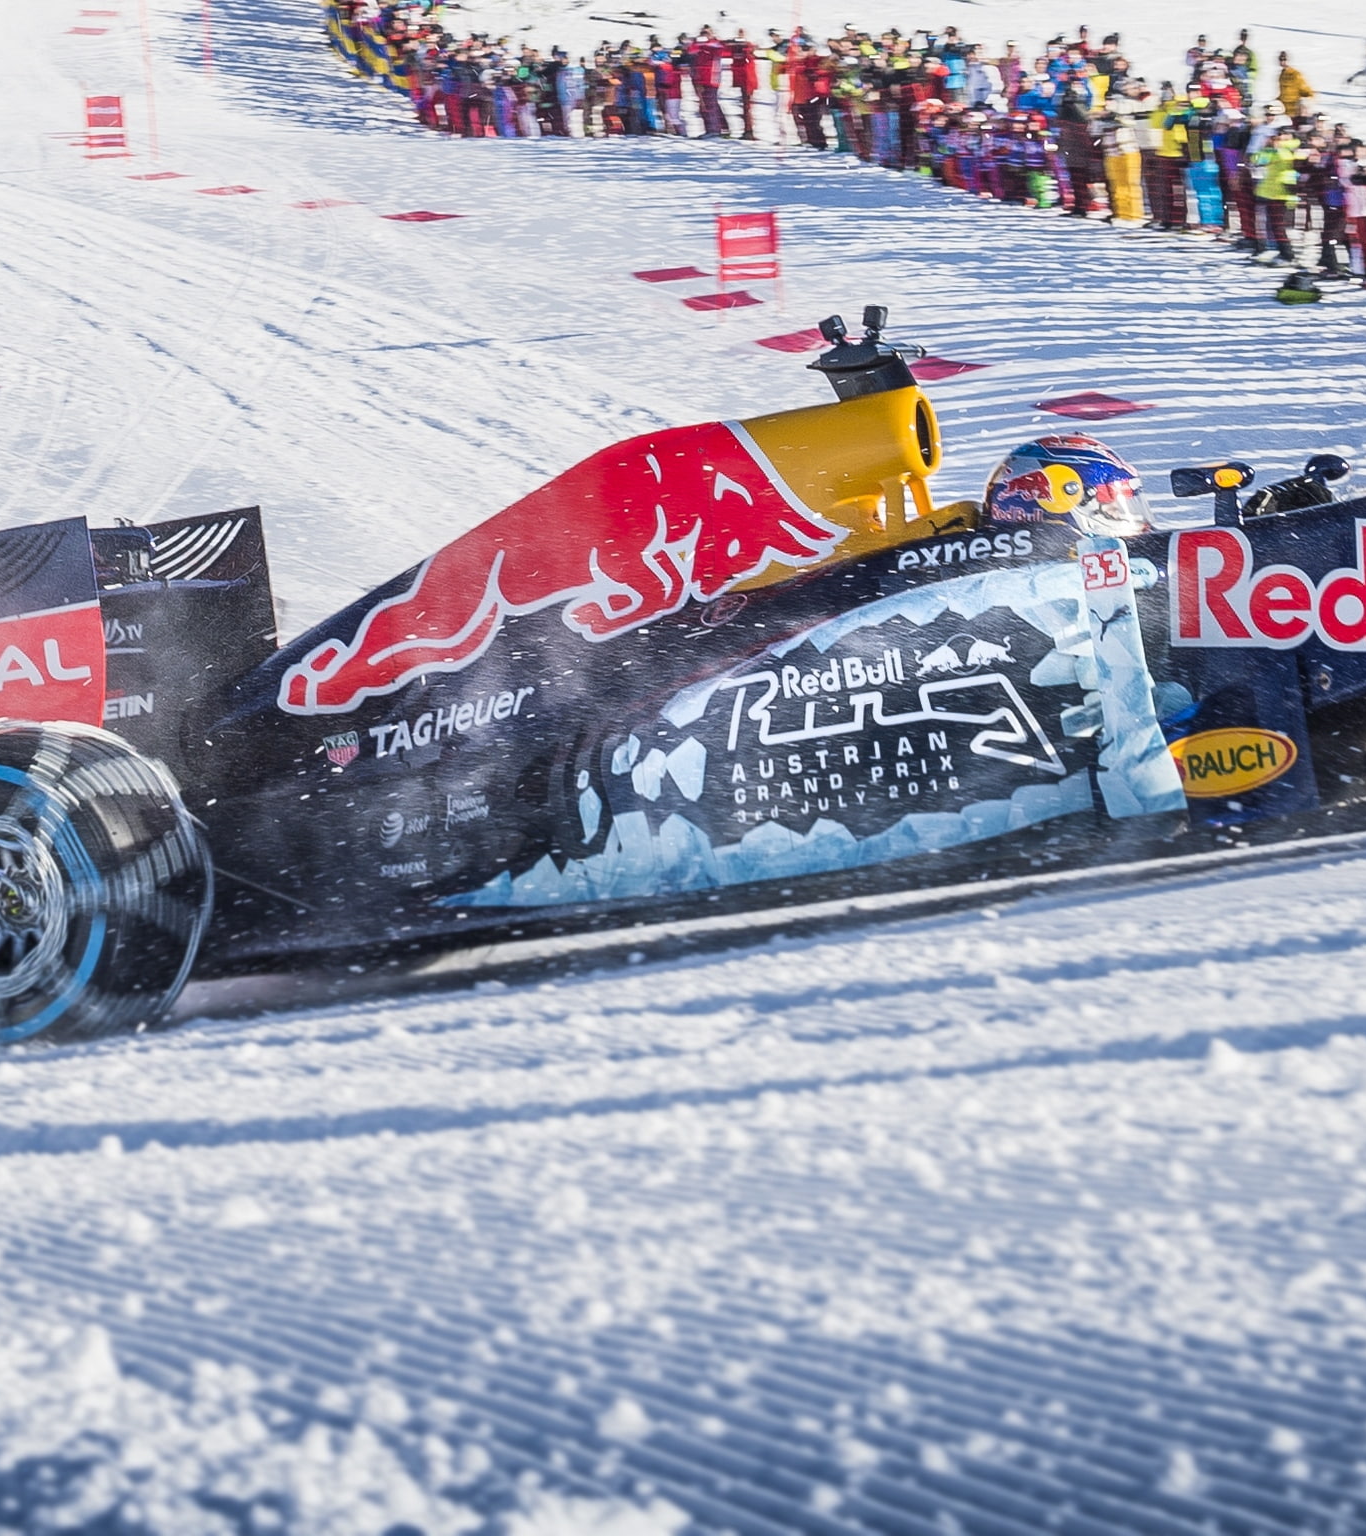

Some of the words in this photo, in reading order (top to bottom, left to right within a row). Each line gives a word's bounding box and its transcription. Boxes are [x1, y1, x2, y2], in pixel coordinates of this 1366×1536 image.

[897, 530, 1033, 571] exness
[1081, 549, 1129, 591] 33
[781, 657, 842, 699] Red
[843, 648, 905, 690] Bull
[326, 734, 357, 749] TAG
[731, 730, 948, 783] AUSTRIAN
[1186, 741, 1277, 781] RAUCH
[734, 773, 844, 805] GRAND
[870, 754, 954, 784] PRIX
[800, 791, 866, 815] JULY
[888, 776, 960, 800] 2016
